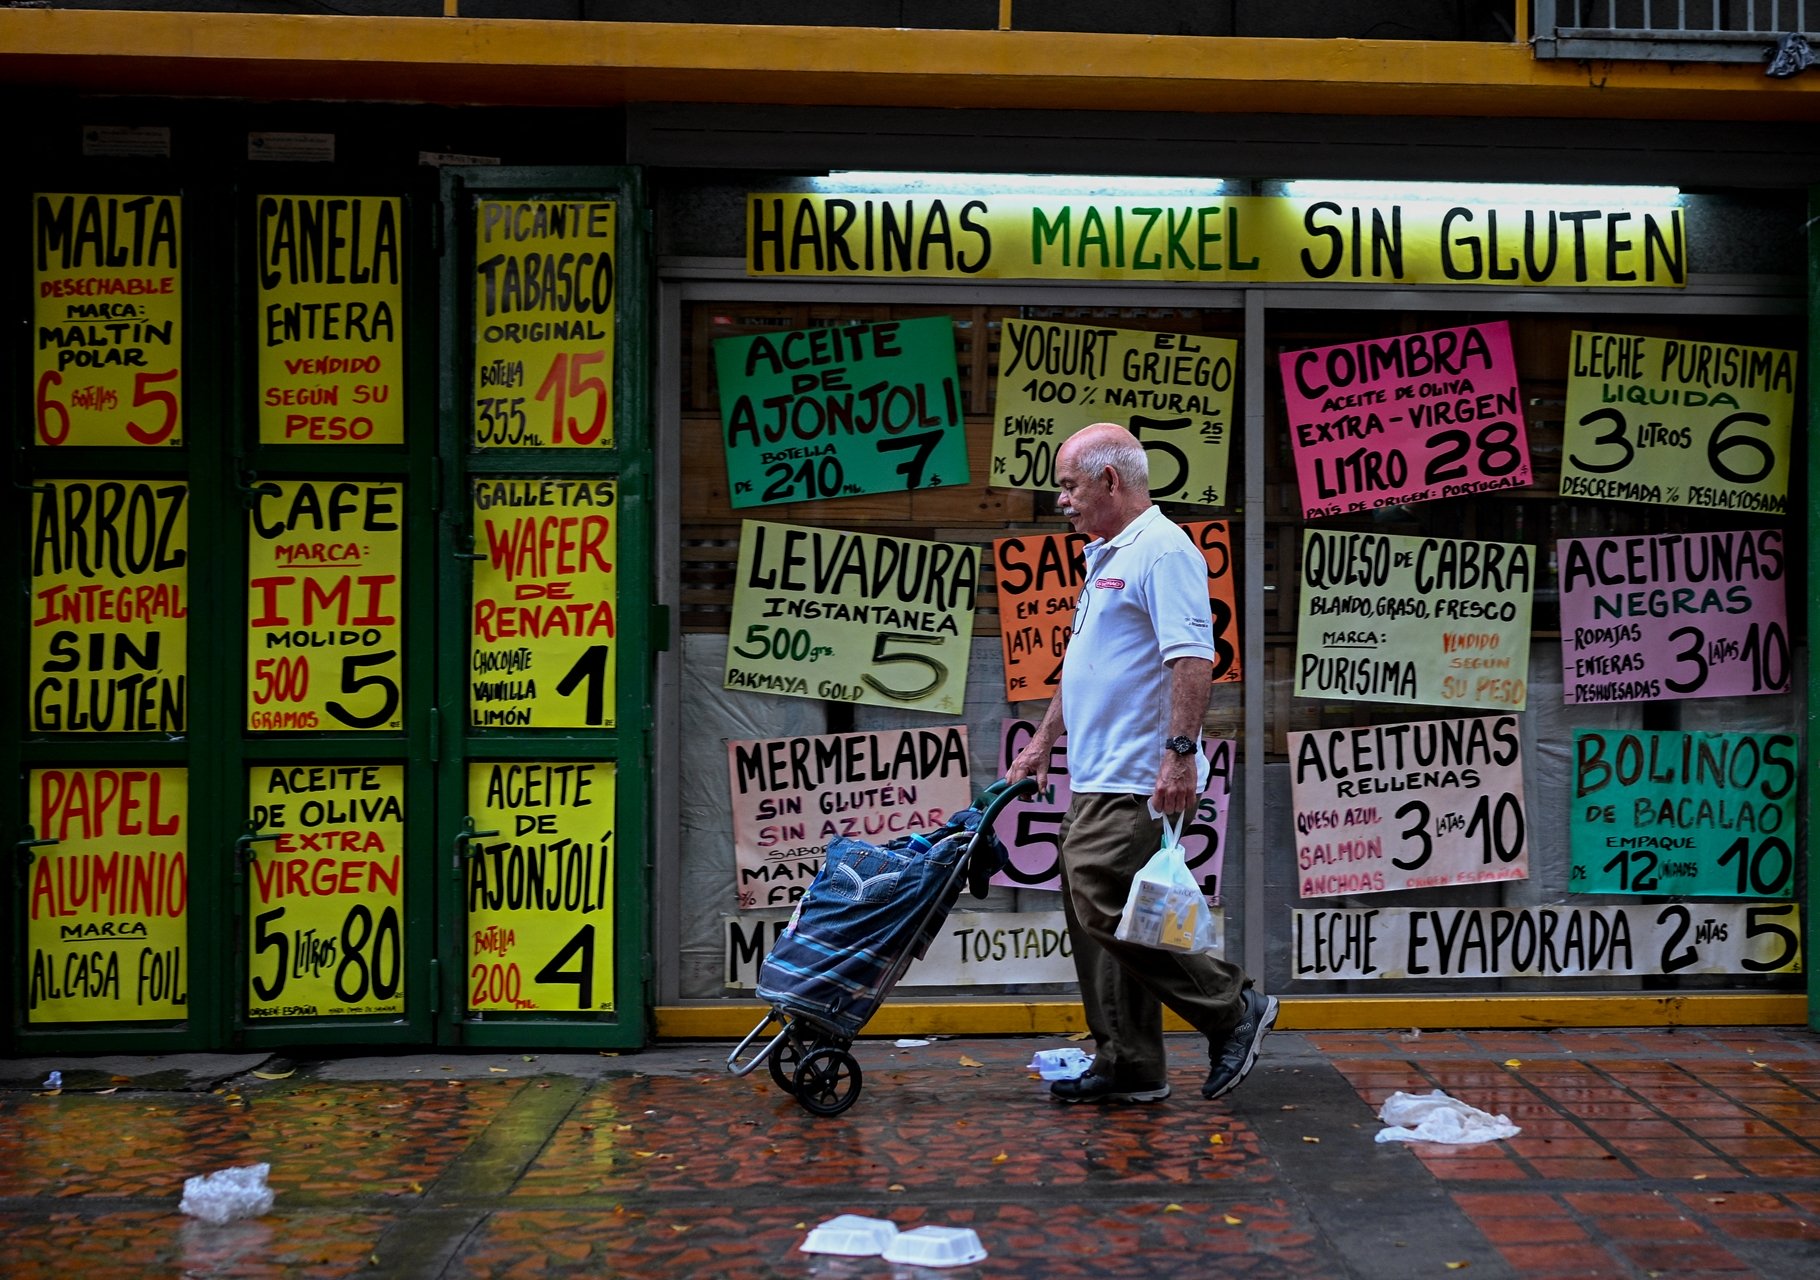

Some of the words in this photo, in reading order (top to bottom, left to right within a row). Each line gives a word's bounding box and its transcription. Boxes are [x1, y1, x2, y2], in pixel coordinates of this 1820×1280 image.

[38, 196, 177, 271] MALTA
[484, 203, 610, 243] PICANTE
[752, 198, 990, 273] HARINAS
[1032, 205, 1259, 270] MAIZKEL
[1301, 202, 1403, 280] SIN
[1440, 207, 1684, 284] GLUTEN
[261, 197, 398, 290] CANELA
[41, 277, 174, 298] DESECHABLE
[478, 252, 613, 317] TABASCO
[67, 303, 145, 320] MARCA:
[267, 301, 393, 347] ENTERA
[484, 320, 605, 343] ORIGINAL
[59, 348, 147, 371] POLAR
[284, 355, 381, 375] VENDIDO
[745, 323, 900, 377] ACEITE
[1004, 322, 1117, 381] YOGURT
[1155, 333, 1200, 352] EL
[1123, 348, 1231, 392] GRIEGO
[1294, 327, 1493, 400] COIMBRA
[1574, 334, 1646, 379] LECHE
[1661, 341, 1792, 394] PURISIMA
[352, 384, 388, 404] SU
[535, 350, 607, 445] 15
[792, 367, 852, 395] DE
[1321, 389, 1386, 413] ACEITE
[1395, 384, 1416, 402] DE
[1419, 378, 1475, 398] OLIVA
[1602, 383, 1740, 409] LIQUIDA
[37, 370, 69, 445] 6
[126, 368, 178, 445] 5
[1105, 387, 1220, 416] NATURAL
[1296, 413, 1384, 448] EXTRA
[1408, 386, 1517, 429] VIRGEN
[285, 414, 374, 440] PESO
[1004, 415, 1054, 436] ENVASE
[1200, 421, 1222, 436] 25
[1569, 407, 1634, 474] 3
[1636, 422, 1692, 449] LITROS
[1707, 412, 1775, 484] 6
[735, 480, 752, 494] DE
[761, 456, 843, 502] 210
[877, 429, 944, 490] 7
[762, 443, 836, 464] BOTELLA
[1314, 447, 1408, 499] LITRO
[1424, 421, 1521, 486] 28
[476, 481, 614, 510] GALLETAS
[1348, 500, 1367, 512] DE
[1562, 476, 1661, 503] DESCREMADA
[33, 483, 188, 577] ARROZ
[485, 515, 612, 582] WAFER
[275, 542, 370, 563] MARCA:
[749, 525, 976, 613] LEVADURA
[1304, 532, 1391, 590] QUESO
[1393, 551, 1413, 568] DE
[1415, 538, 1530, 595] CABRA
[1564, 530, 1784, 593] ACEITUNAS
[34, 584, 188, 627] INTEGRAL
[251, 575, 396, 627] IMI
[515, 581, 575, 601] DE
[1016, 600, 1039, 619] EN
[1434, 600, 1517, 622] FRESCO
[1594, 585, 1752, 620] NEGRAS
[474, 598, 615, 643] RENATA
[762, 597, 958, 637] INSTANTANEA
[43, 631, 160, 672] SIN
[266, 628, 381, 648] MOLIDO
[1006, 625, 1043, 666] LATA
[1665, 626, 1708, 693] 3
[1708, 637, 1739, 666] LATAS
[1740, 621, 1791, 692] 10
[473, 647, 533, 675] CHOCOLATE
[861, 631, 949, 702] 5
[1301, 654, 1417, 699] PURISIMA
[252, 655, 308, 705] 500
[325, 650, 399, 728] 5
[473, 678, 537, 703] VAINILLA
[555, 644, 609, 726] 1
[728, 668, 808, 695] PAKMAYA
[818, 680, 864, 701] GOLD
[1009, 676, 1027, 691] DE
[1441, 675, 1468, 699] SU
[1475, 676, 1526, 705] PESO
[251, 711, 319, 730] GRAMOS
[473, 705, 531, 726] LIMÓN
[736, 728, 968, 794] MERMELADA
[1297, 717, 1518, 784] ACEITUNAS
[268, 766, 381, 794] ACEITE
[487, 764, 595, 809] ACEITE
[1337, 769, 1480, 798] RELLENAS
[41, 770, 179, 840] PAPEL
[253, 804, 285, 831] DE
[300, 795, 403, 827] OLIVA
[755, 796, 802, 821] SIN
[1297, 809, 1339, 836] QUESO
[1343, 806, 1382, 827] AZUL
[1586, 804, 1616, 824] DE
[1634, 797, 1783, 834] BACALAO
[275, 831, 385, 854] EXTRA
[515, 815, 558, 837] DE
[758, 822, 805, 848] SIN
[1392, 800, 1433, 871] 3
[1435, 812, 1465, 838] LATAS
[1465, 792, 1524, 864] 10
[1606, 836, 1696, 851] EMPAQUE
[32, 851, 187, 920] ALUMINIO
[253, 855, 400, 904] VIRGEN
[1302, 870, 1384, 896] ANCHOAS
[1572, 865, 1586, 880] DE
[1603, 850, 1658, 892] 12
[1717, 836, 1792, 895] 10
[61, 921, 147, 938] MARCA
[1298, 909, 1379, 975] LECHE
[1407, 910, 1632, 975] EVAPORADA
[1656, 904, 1698, 974] 2
[1695, 918, 1728, 944] LATAS
[1740, 904, 1798, 972] 5
[252, 906, 288, 1002] 5
[293, 929, 337, 980] LITROS
[334, 904, 400, 1003] 80
[534, 923, 594, 1010] 4
[31, 949, 119, 1010] ALCASA
[138, 946, 186, 1006] FOIL
